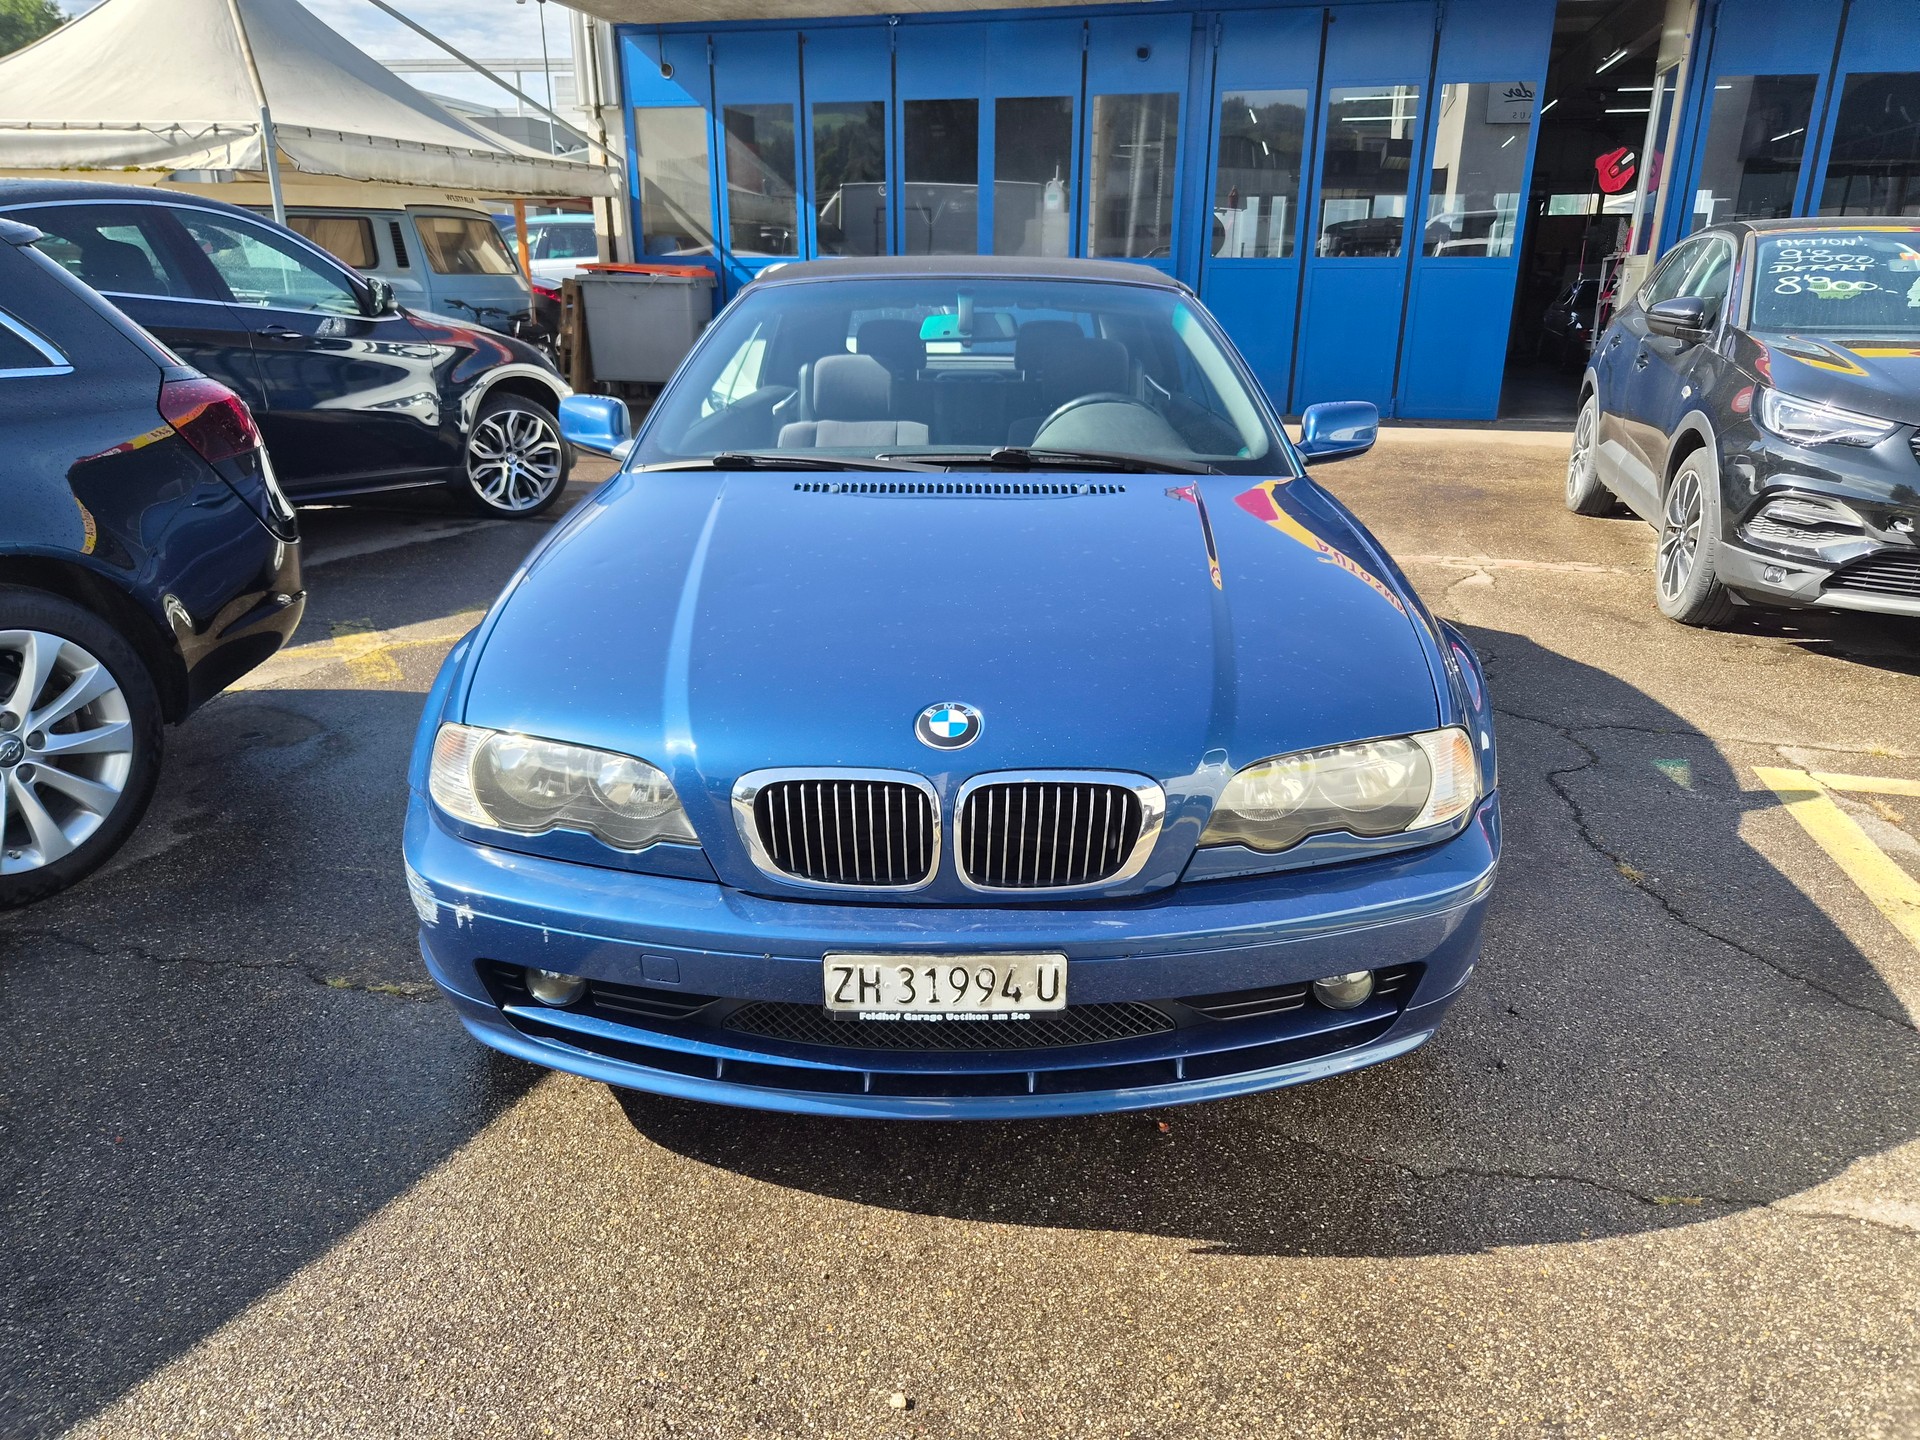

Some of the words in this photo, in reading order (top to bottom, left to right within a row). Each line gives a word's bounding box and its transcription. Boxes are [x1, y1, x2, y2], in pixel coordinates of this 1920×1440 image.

[1768, 263, 1875, 273] DEFEKT
[923, 703, 976, 718] BMW
[832, 967, 881, 1003] ZH
[897, 966, 1022, 1004] 319994
[1036, 966, 1060, 1002] U
[859, 1012, 900, 1021] Feldhof
[903, 1012, 943, 1022] Garage
[945, 1012, 989, 1021] Uetikon
[1011, 1012, 1031, 1020] See
